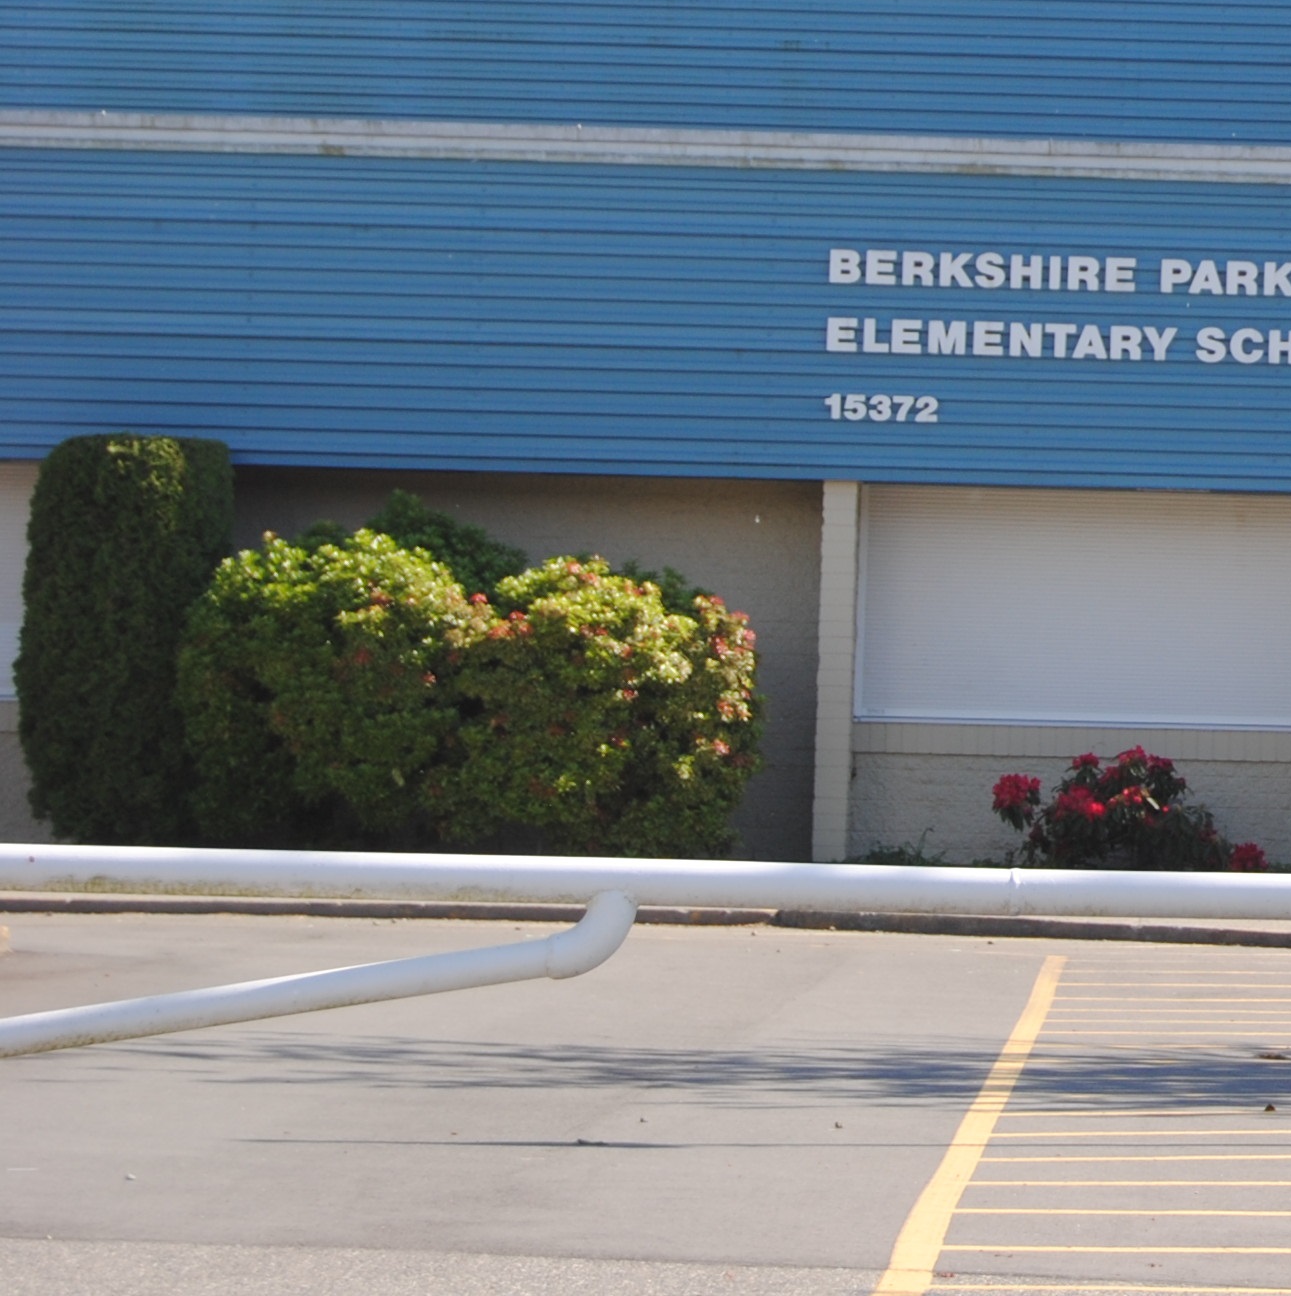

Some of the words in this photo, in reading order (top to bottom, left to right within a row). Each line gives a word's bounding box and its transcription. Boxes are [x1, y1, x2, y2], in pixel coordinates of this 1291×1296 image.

[829, 249, 1137, 292] BERKSHIRE
[826, 317, 1178, 361] ELEMENTARY
[824, 393, 938, 422] 15372
